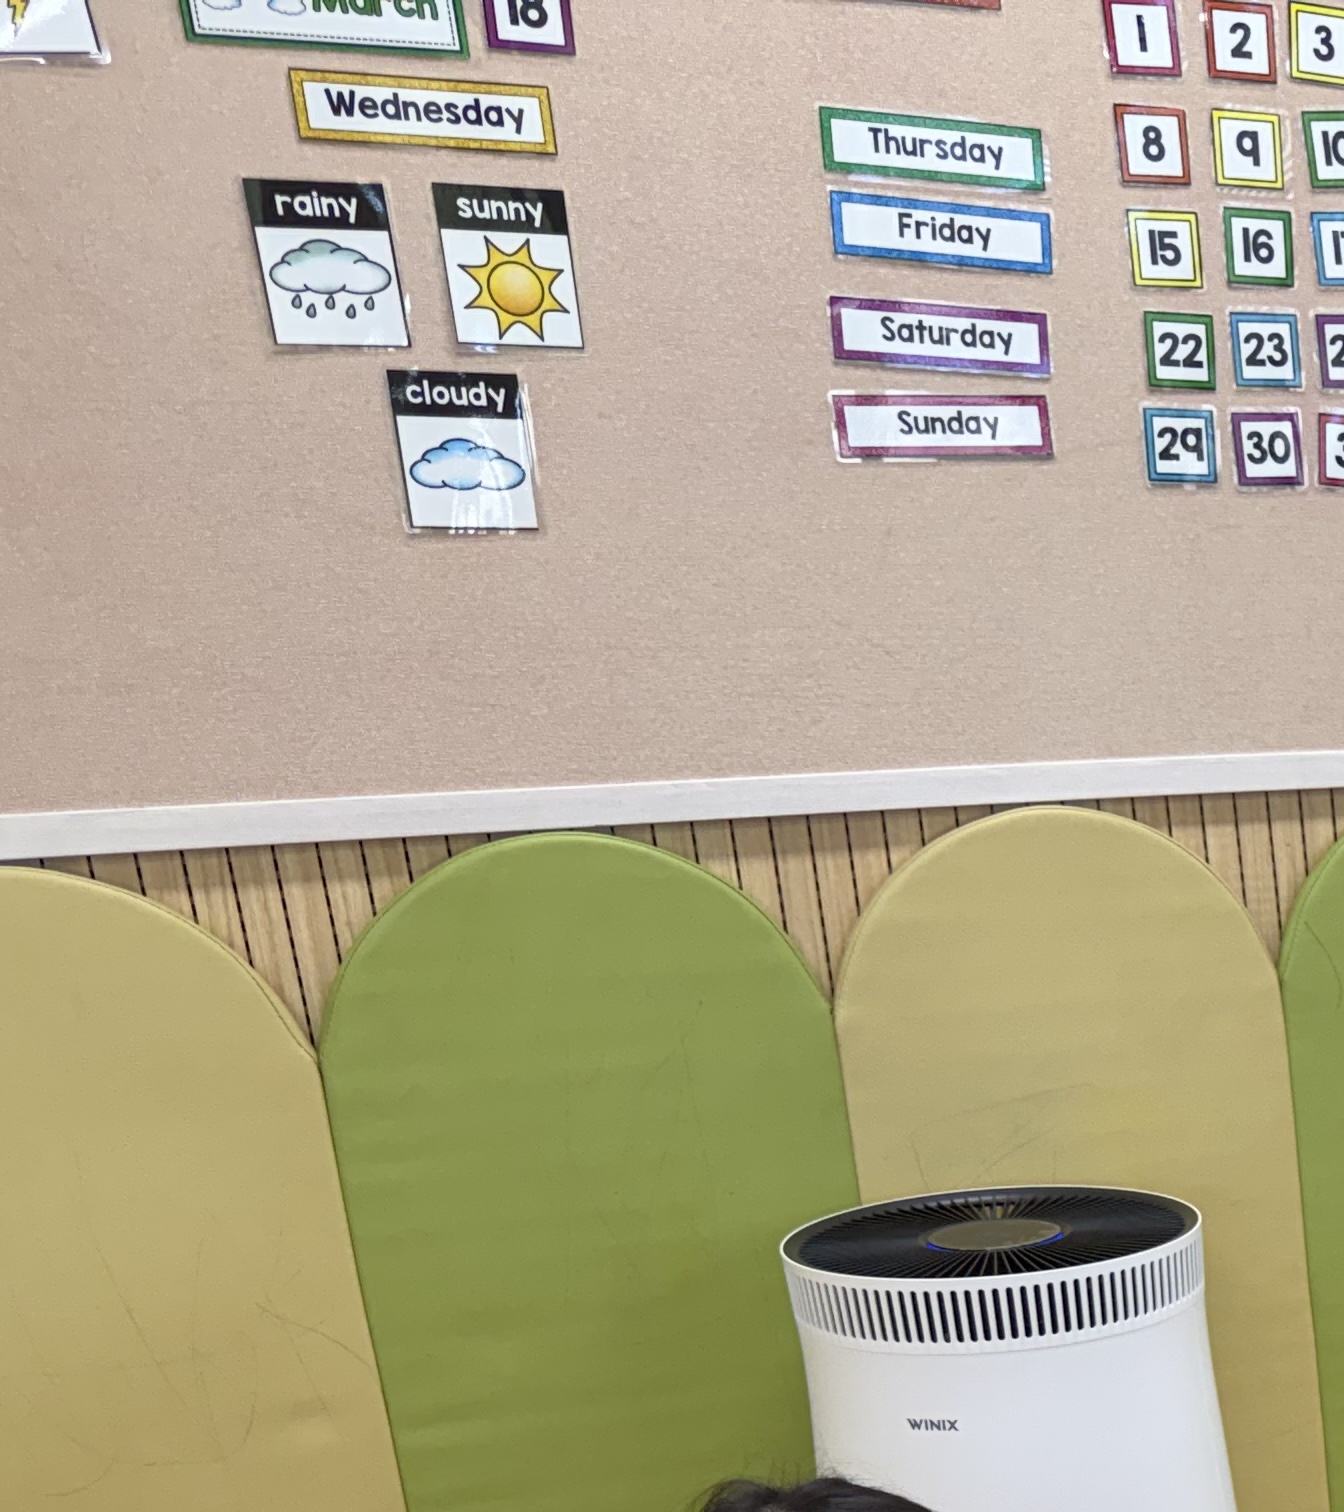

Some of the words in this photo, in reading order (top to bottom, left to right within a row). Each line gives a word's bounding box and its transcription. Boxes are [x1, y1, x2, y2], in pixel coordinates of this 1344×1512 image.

[506, 0, 549, 29] 18
[1135, 14, 1148, 53] 1
[1229, 21, 1253, 60] 2
[1312, 24, 1335, 62] 3
[323, 87, 525, 136] Wednesday
[867, 126, 1004, 171] Thursday
[1142, 125, 1166, 163] 8
[1235, 129, 1261, 167] 9
[274, 190, 358, 224] rainy
[456, 196, 543, 228] sunny
[897, 211, 992, 253] Friday
[1147, 228, 1182, 267] 15
[1241, 226, 1275, 265] 16
[880, 315, 1013, 357] Saturday
[1157, 331, 1204, 369] 22
[1243, 332, 1289, 368] 23
[405, 379, 506, 413] cloudy
[897, 409, 999, 441] Sunday
[1156, 426, 1205, 462] 29
[1246, 430, 1291, 465] 30
[906, 1418, 959, 1432] WINIX
